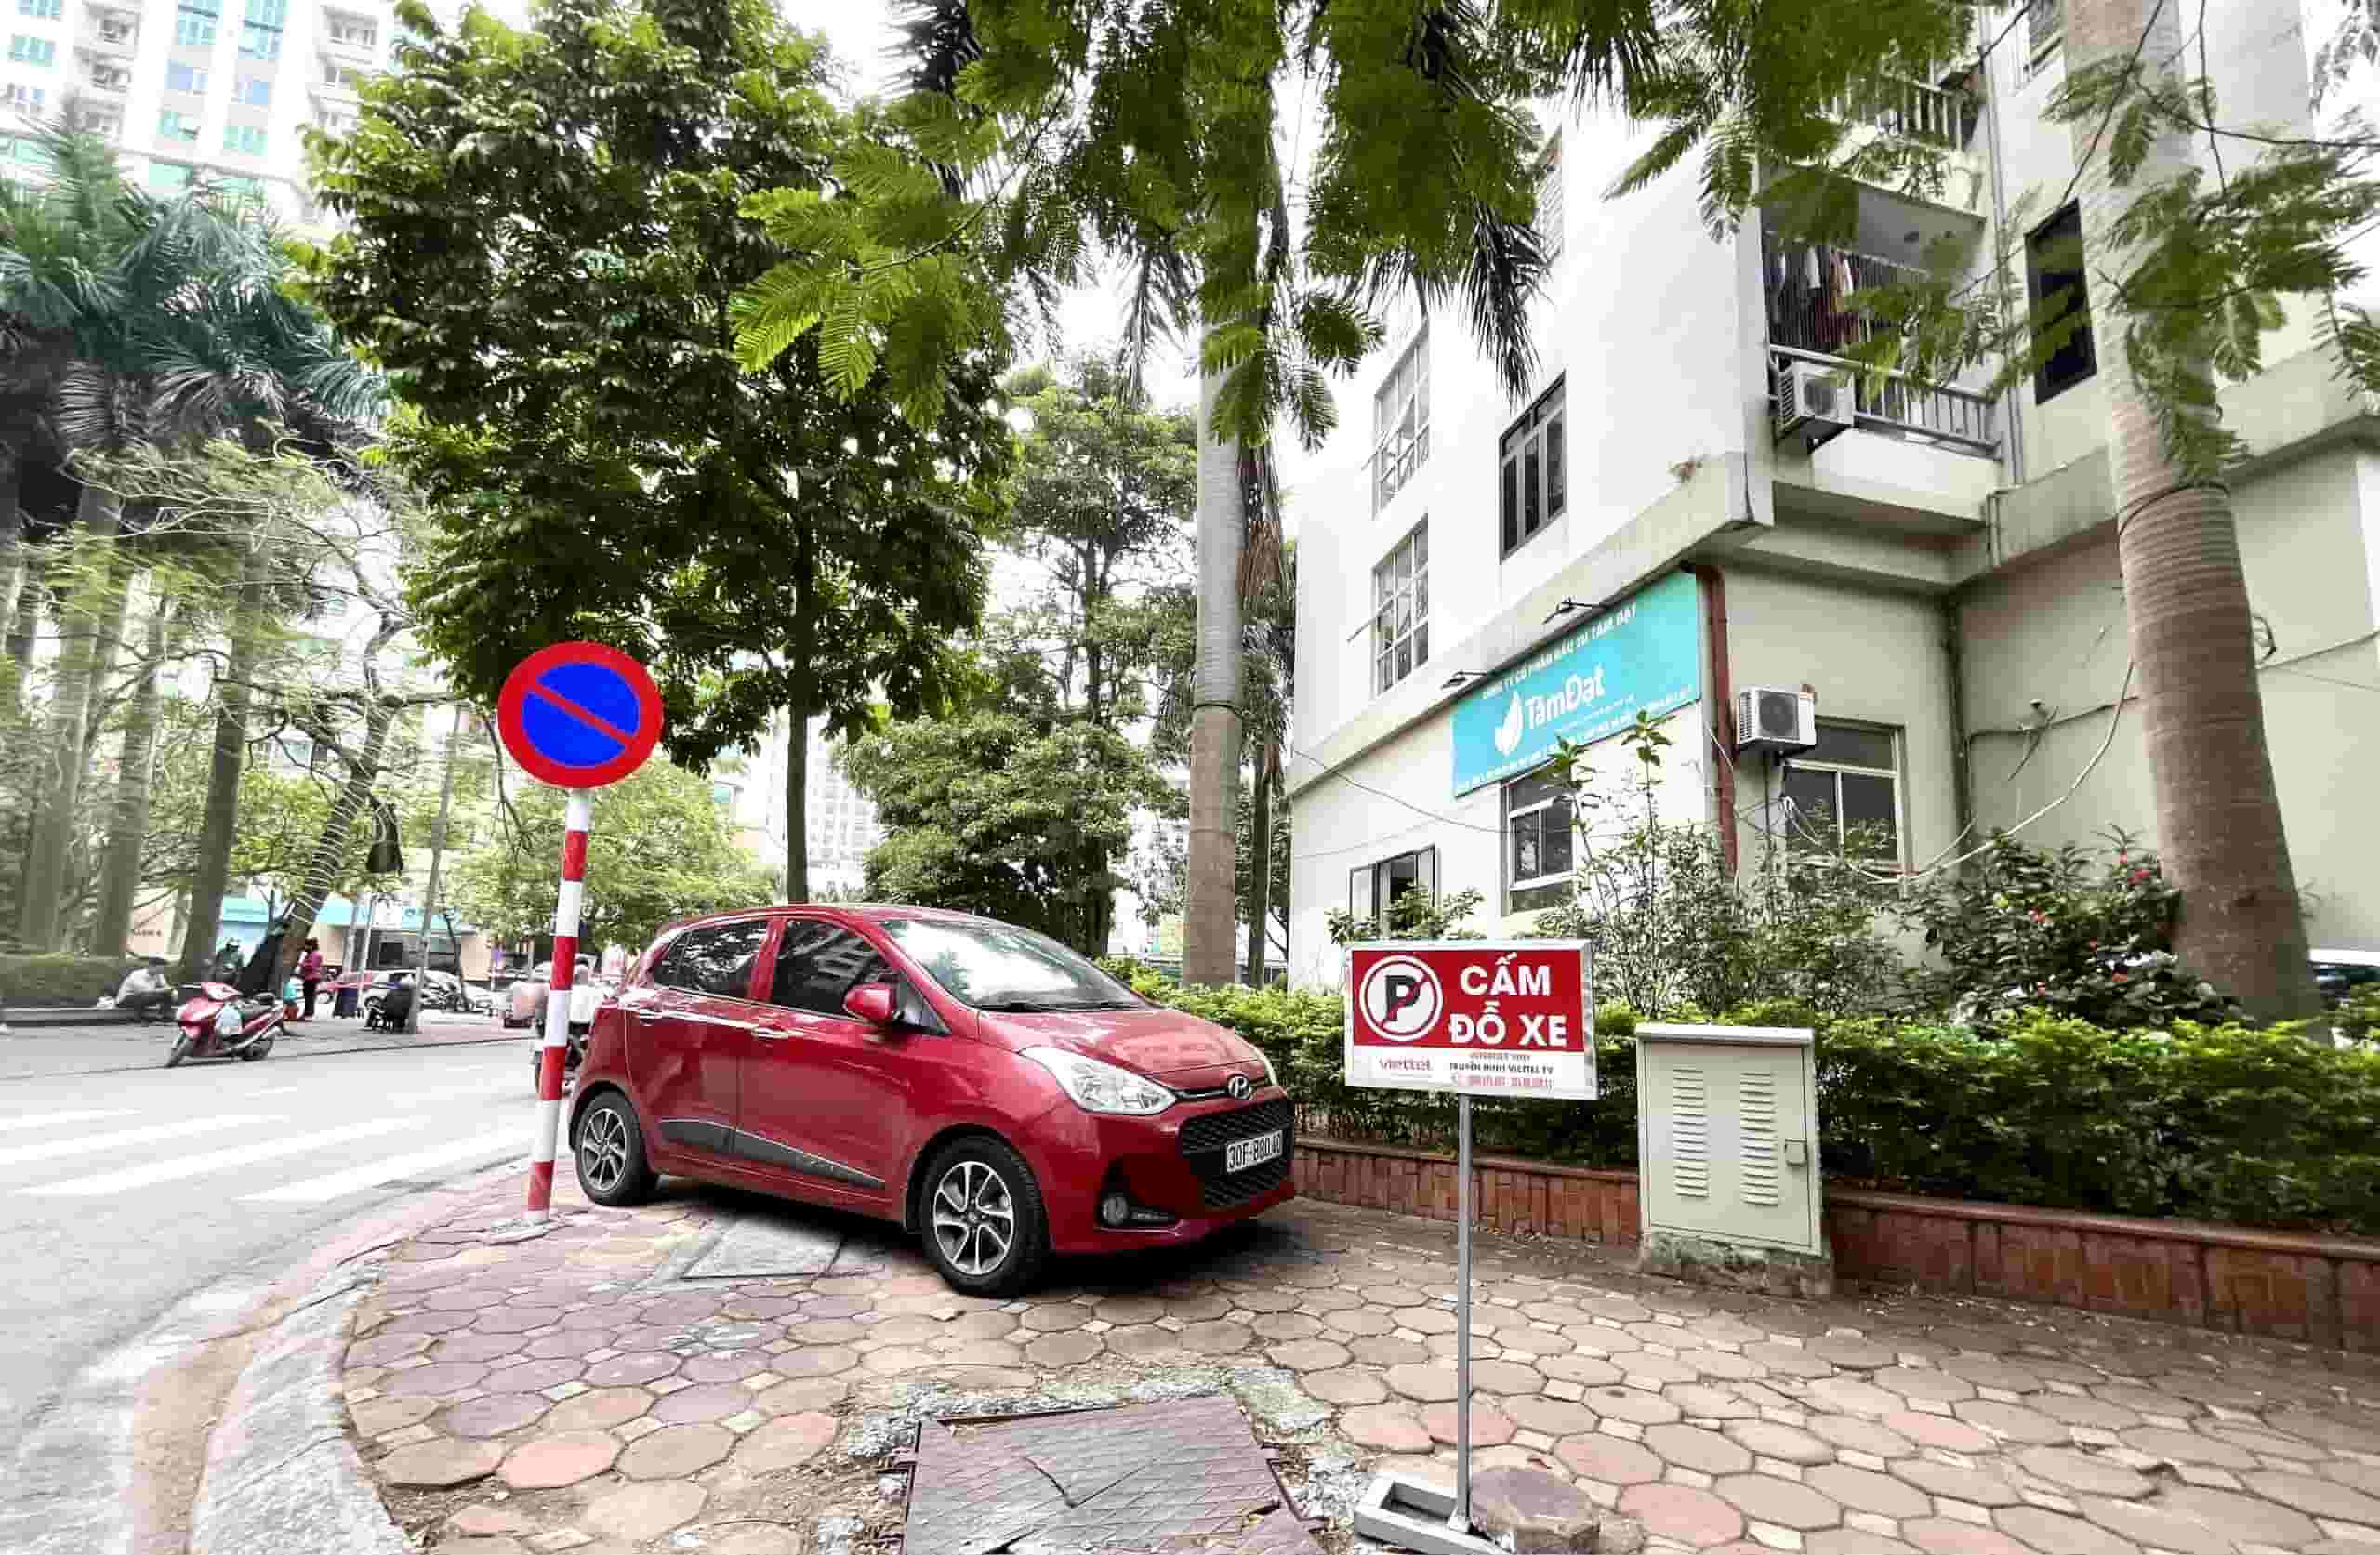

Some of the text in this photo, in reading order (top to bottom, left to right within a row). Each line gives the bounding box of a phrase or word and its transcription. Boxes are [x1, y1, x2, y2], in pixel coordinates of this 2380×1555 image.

[1460, 952, 1552, 996] CẤM
[1448, 1000, 1567, 1047] ĐỖ XE
